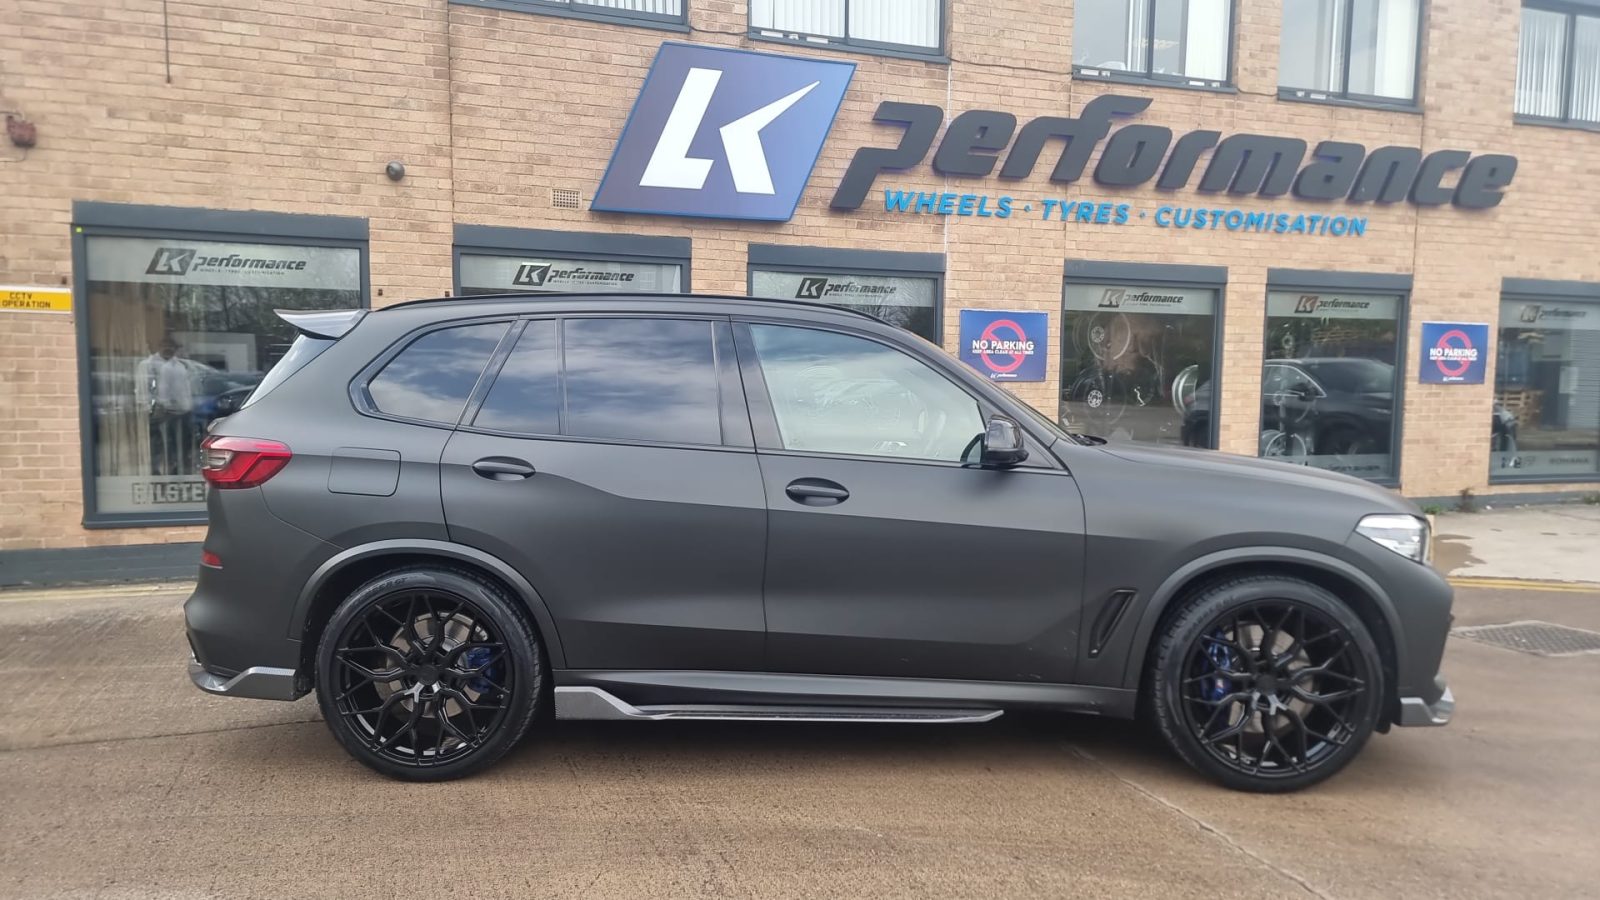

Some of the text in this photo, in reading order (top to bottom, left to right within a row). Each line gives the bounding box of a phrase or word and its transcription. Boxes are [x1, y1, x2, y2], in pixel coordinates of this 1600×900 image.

[829, 93, 1519, 212] performance
[884, 189, 1368, 237] WHEELS TYRES CUSTOMISATION
[191, 254, 307, 272] performance
[547, 267, 635, 283] performance
[9, 291, 33, 300] CCTV
[824, 282, 897, 296] performance
[1, 299, 52, 309] OPERATION
[972, 339, 1035, 351] NO PARKING
[1429, 347, 1478, 358] NO PARKING
[132, 481, 208, 505] BILSTE
